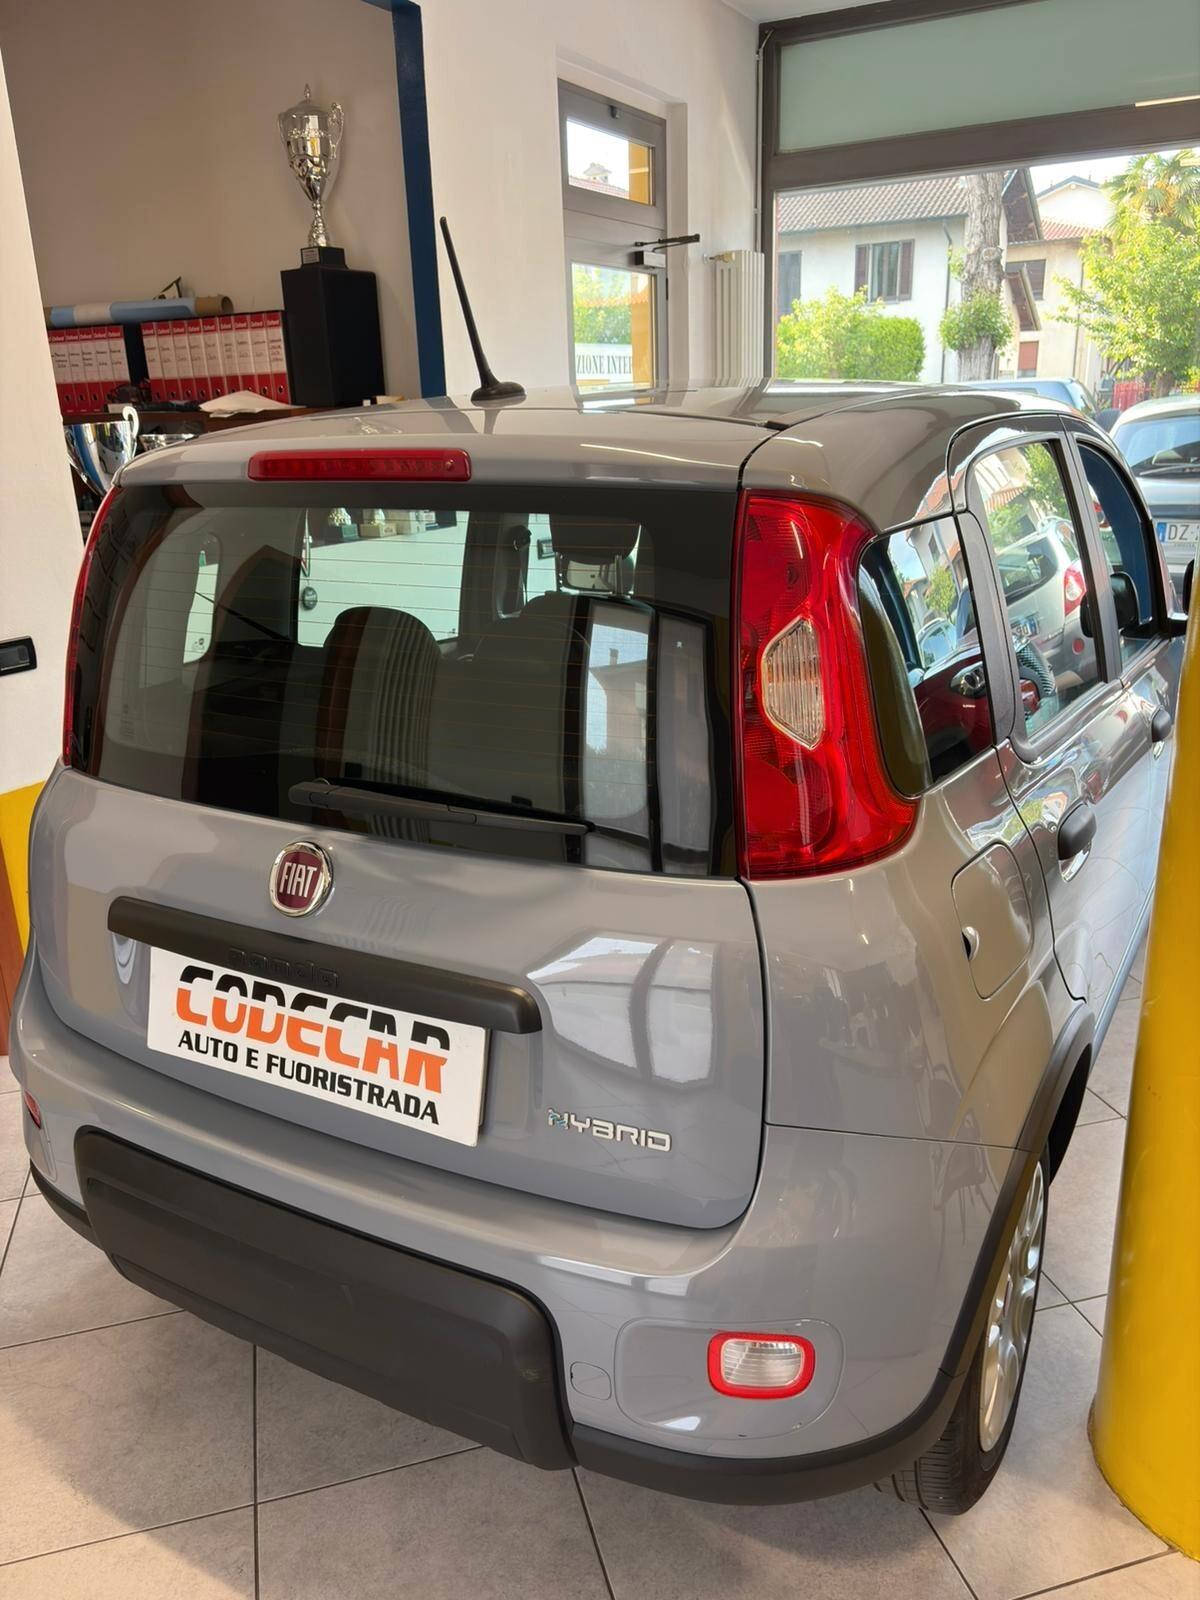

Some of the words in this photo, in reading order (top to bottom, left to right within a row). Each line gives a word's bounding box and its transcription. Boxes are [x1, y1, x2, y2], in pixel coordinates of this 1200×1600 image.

[279, 861, 318, 898] FIAT
[175, 965, 451, 1094] CODECAR
[177, 1029, 239, 1063] AUTO
[246, 1046, 260, 1070] E
[266, 1052, 440, 1126] FUORISTRADA
[547, 1107, 672, 1153] HYBRID
